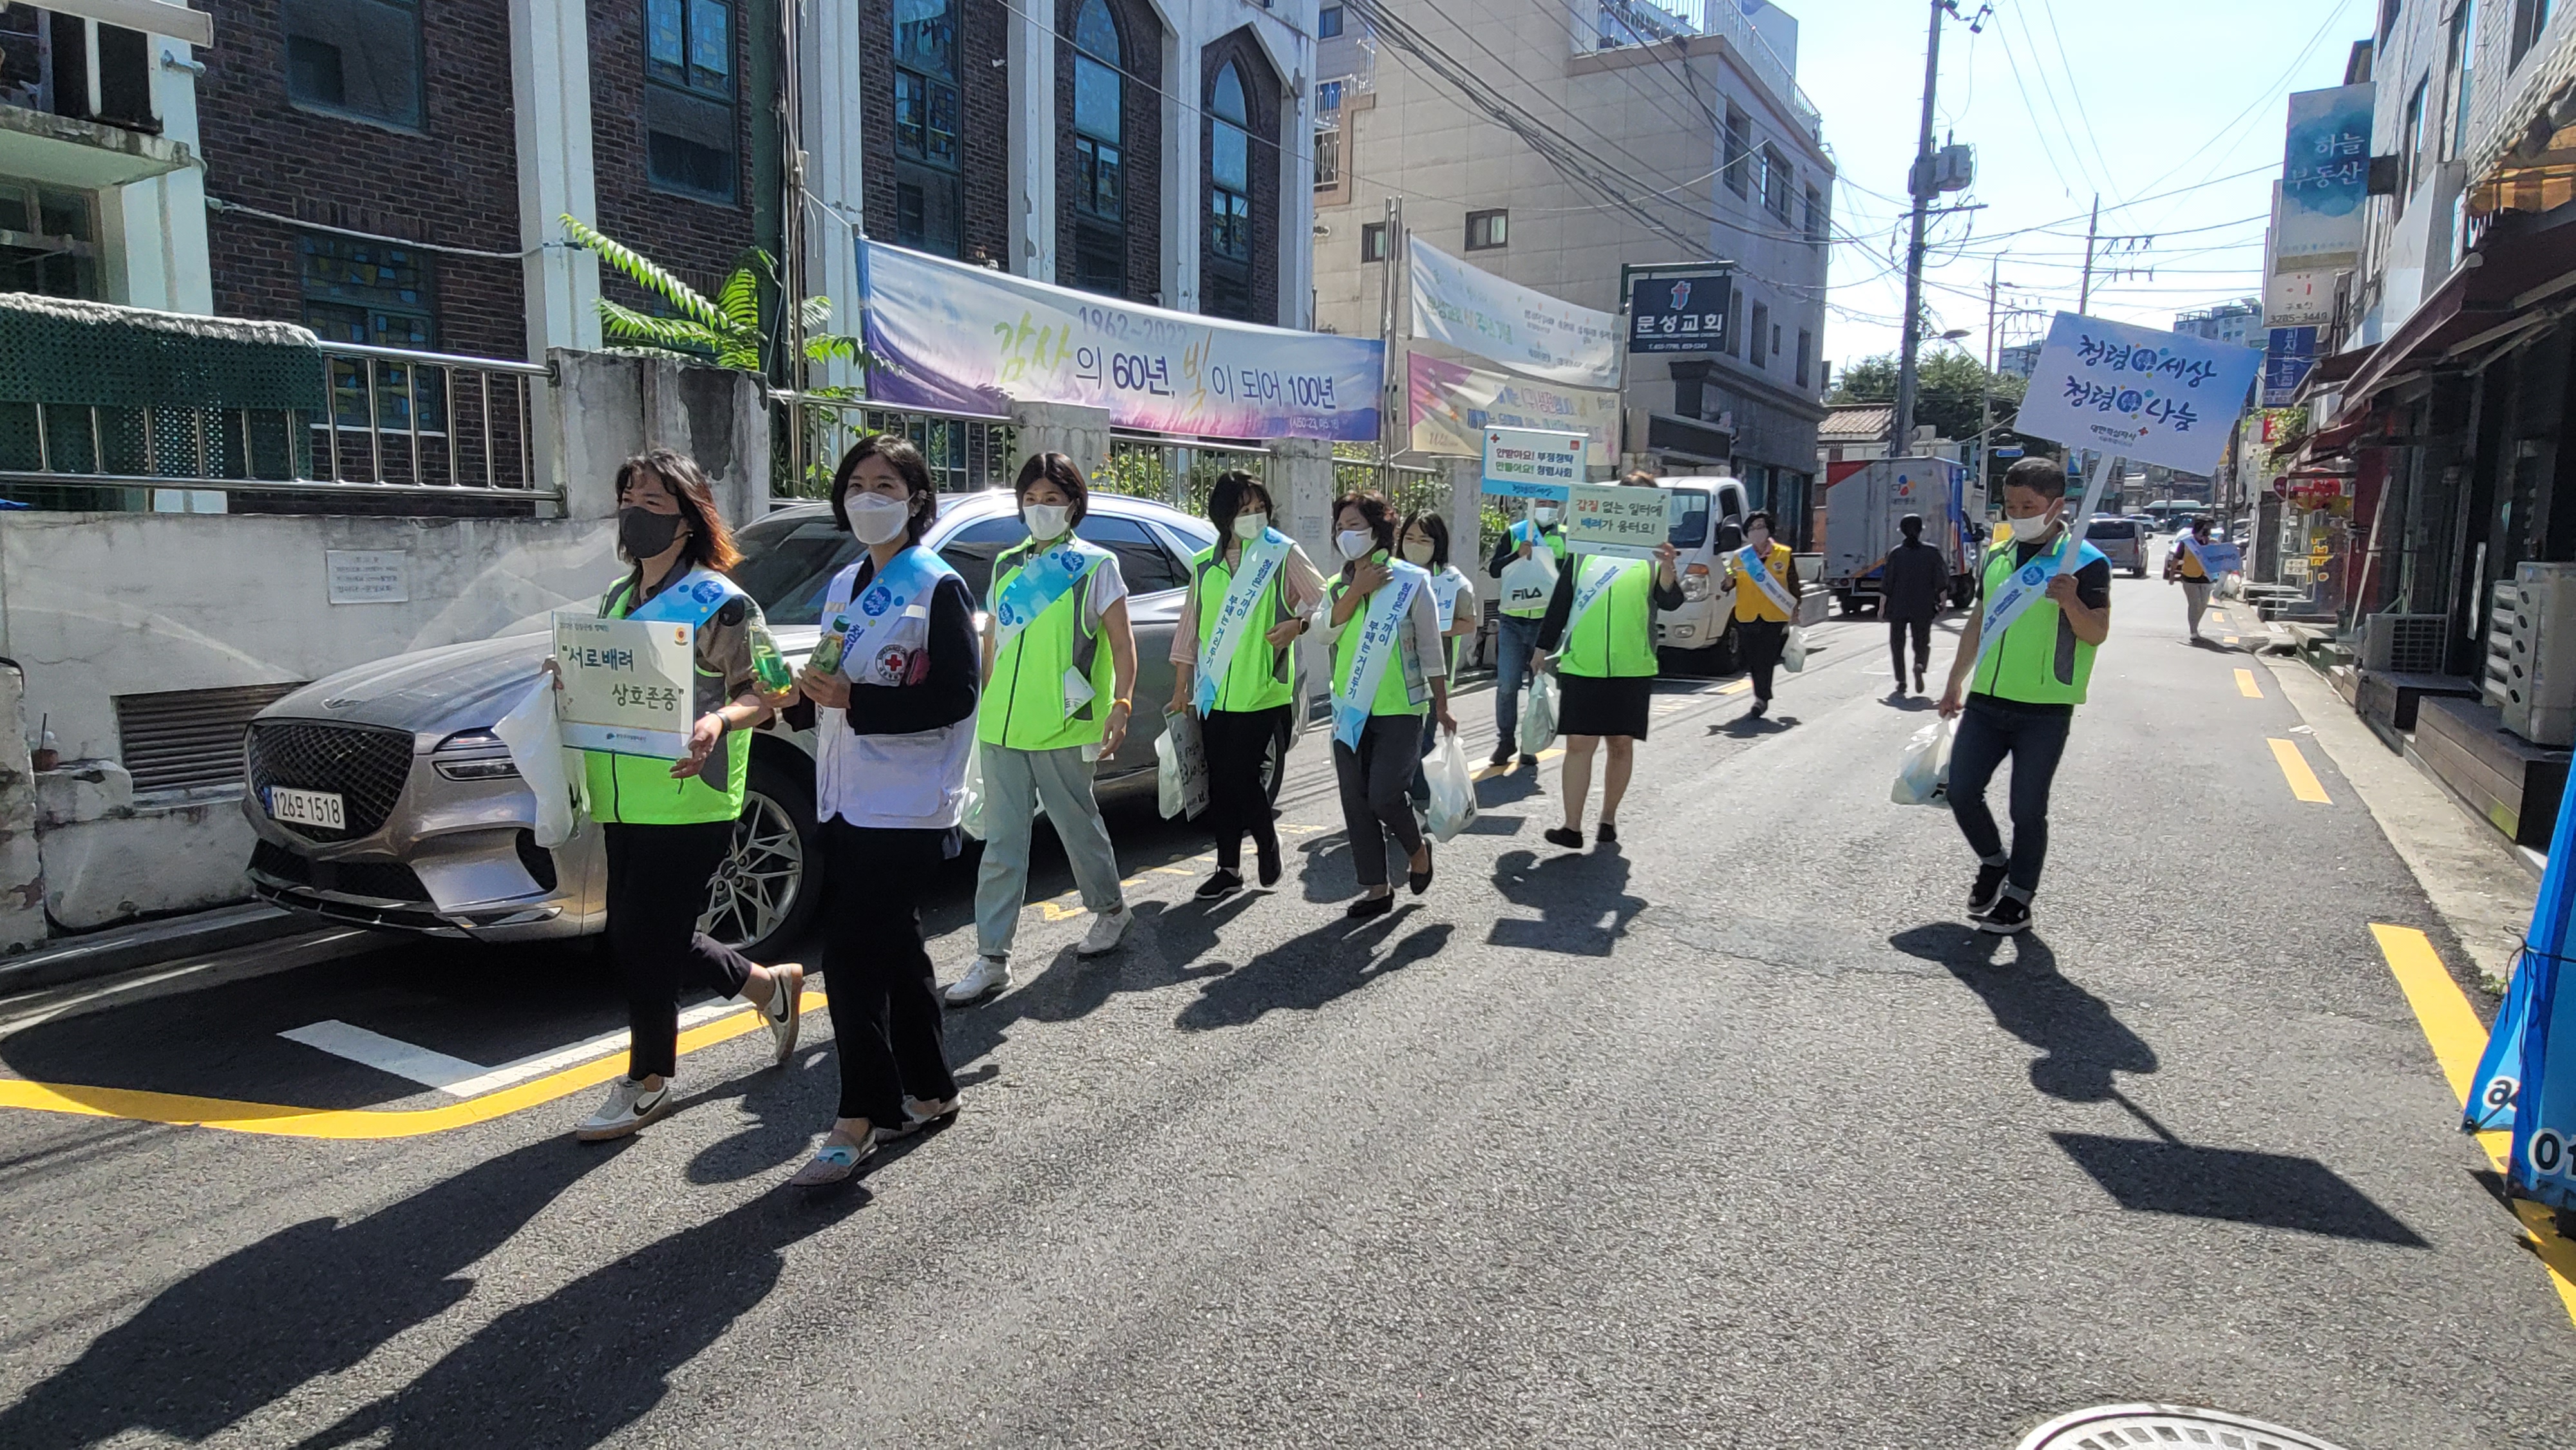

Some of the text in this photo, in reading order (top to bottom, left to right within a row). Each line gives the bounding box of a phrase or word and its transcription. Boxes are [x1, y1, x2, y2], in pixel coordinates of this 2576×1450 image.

[2315, 132, 2365, 158] 하늘
[2288, 161, 2363, 191] 부동산
[1636, 313, 1723, 334] 문성교회
[2077, 334, 2217, 388] 청렴 세상
[1112, 352, 1175, 399] 60년,
[1240, 368, 1282, 408] 되어
[1287, 375, 1337, 410] 100년
[2063, 375, 2117, 412] 청렴
[1495, 447, 1535, 461] 안받아요!
[1495, 460, 1535, 475] 만들어요!
[1576, 498, 1663, 518] 갑질 없는 일터에
[1617, 520, 1656, 535] 움터요!
[1236, 588, 1256, 621] 가까이
[1392, 582, 1414, 612] 청렴은
[1511, 586, 1543, 601] FILA
[1206, 594, 1239, 669] 부패는 거리두기
[1378, 612, 1398, 646] 가까이
[1348, 619, 1379, 700] 부패는 거리두기
[273, 791, 341, 824] 126모 1518
